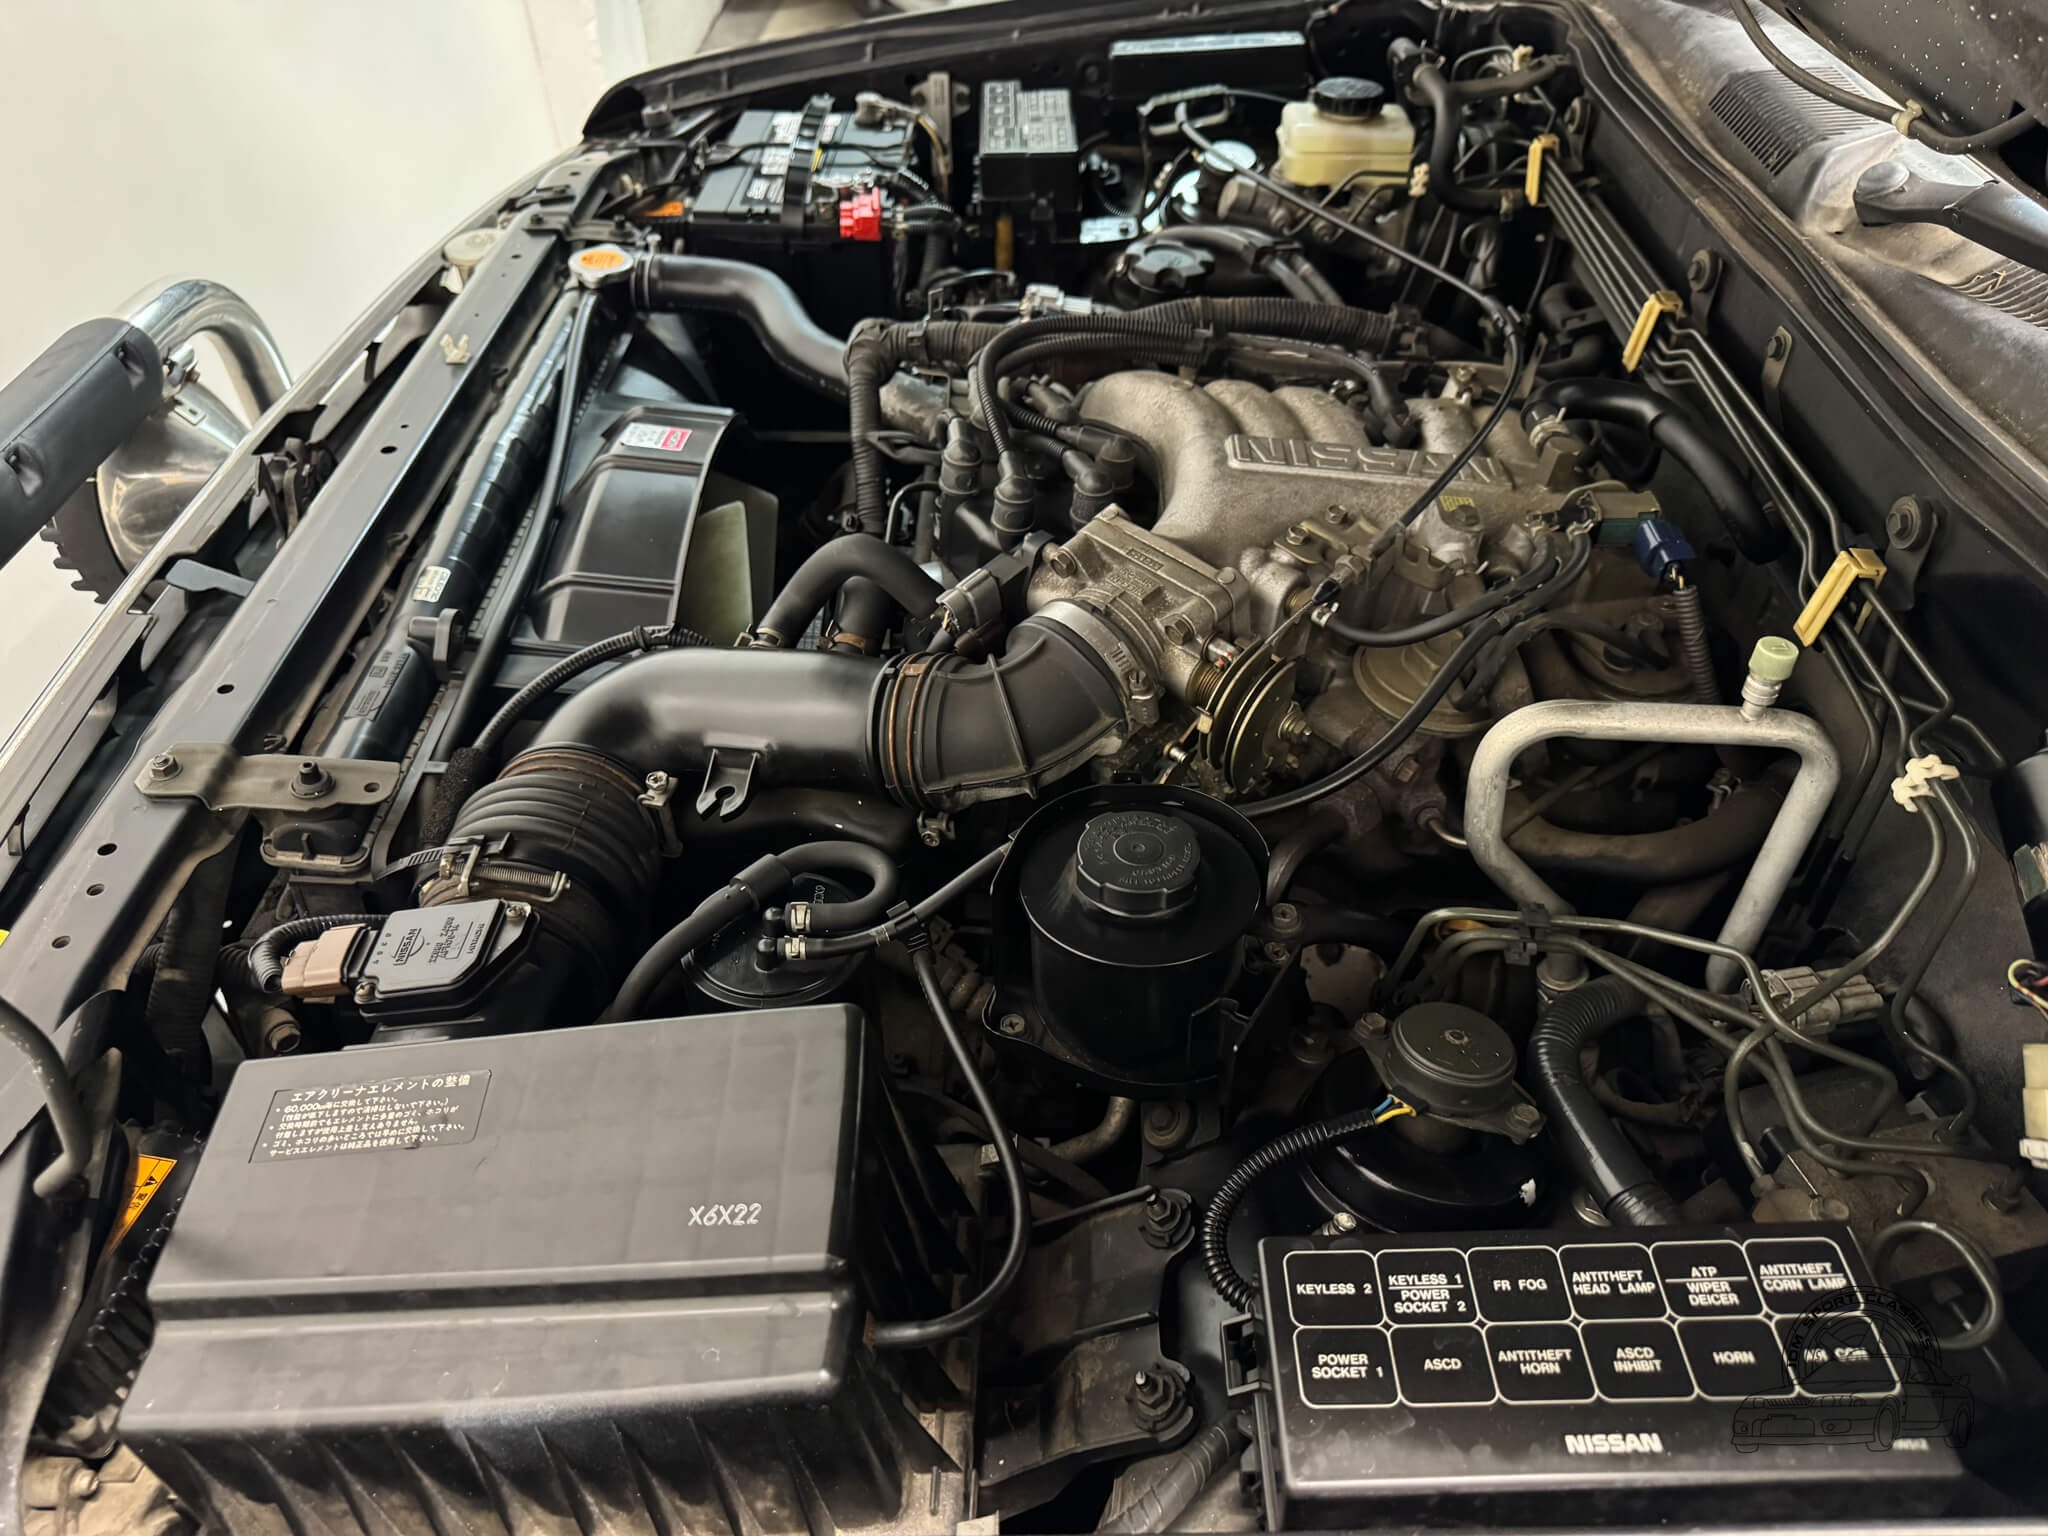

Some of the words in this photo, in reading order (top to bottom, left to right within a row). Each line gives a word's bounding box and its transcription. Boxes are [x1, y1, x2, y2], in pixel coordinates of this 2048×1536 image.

[1232, 434, 1498, 483] NISSAN
[396, 928, 418, 963] NISSAN
[290, 1074, 471, 1102] エアクリーナエレメントの整備
[687, 1202, 763, 1227] X6X22
[1690, 1265, 1720, 1279] ATP
[1759, 1262, 1832, 1276] ANTITHEFT
[1387, 1273, 1448, 1286] KEYLESS
[1454, 1272, 1463, 1285] 1
[1571, 1270, 1644, 1284] ANTITHEFT
[1296, 1282, 1356, 1296] KEYLESS
[1363, 1282, 1374, 1295] 2
[1492, 1279, 1512, 1292] FR
[1518, 1278, 1548, 1291] FOG
[1572, 1283, 1611, 1296] HEAD
[1616, 1281, 1657, 1295] LAMP
[1685, 1281, 1733, 1294] WIPER
[1762, 1278, 1803, 1292] CORN
[1806, 1277, 1850, 1291] LAMP
[1399, 1289, 1450, 1302] POWER
[1688, 1293, 1740, 1307] DEICER
[1393, 1301, 1449, 1314] SOCKET
[1456, 1300, 1467, 1312] 2
[1316, 1353, 1369, 1367] POWER
[1497, 1348, 1573, 1362] ANTITHEFT
[1616, 1346, 1656, 1360] ASCD
[1712, 1350, 1756, 1365] HORN
[1423, 1357, 1462, 1371] ASCD
[1519, 1361, 1561, 1375] HORN
[1612, 1359, 1663, 1373] INHIBIT
[1311, 1366, 1368, 1380] SOCKET
[1375, 1366, 1384, 1379] 1
[1564, 1432, 1664, 1455] NISSAN
